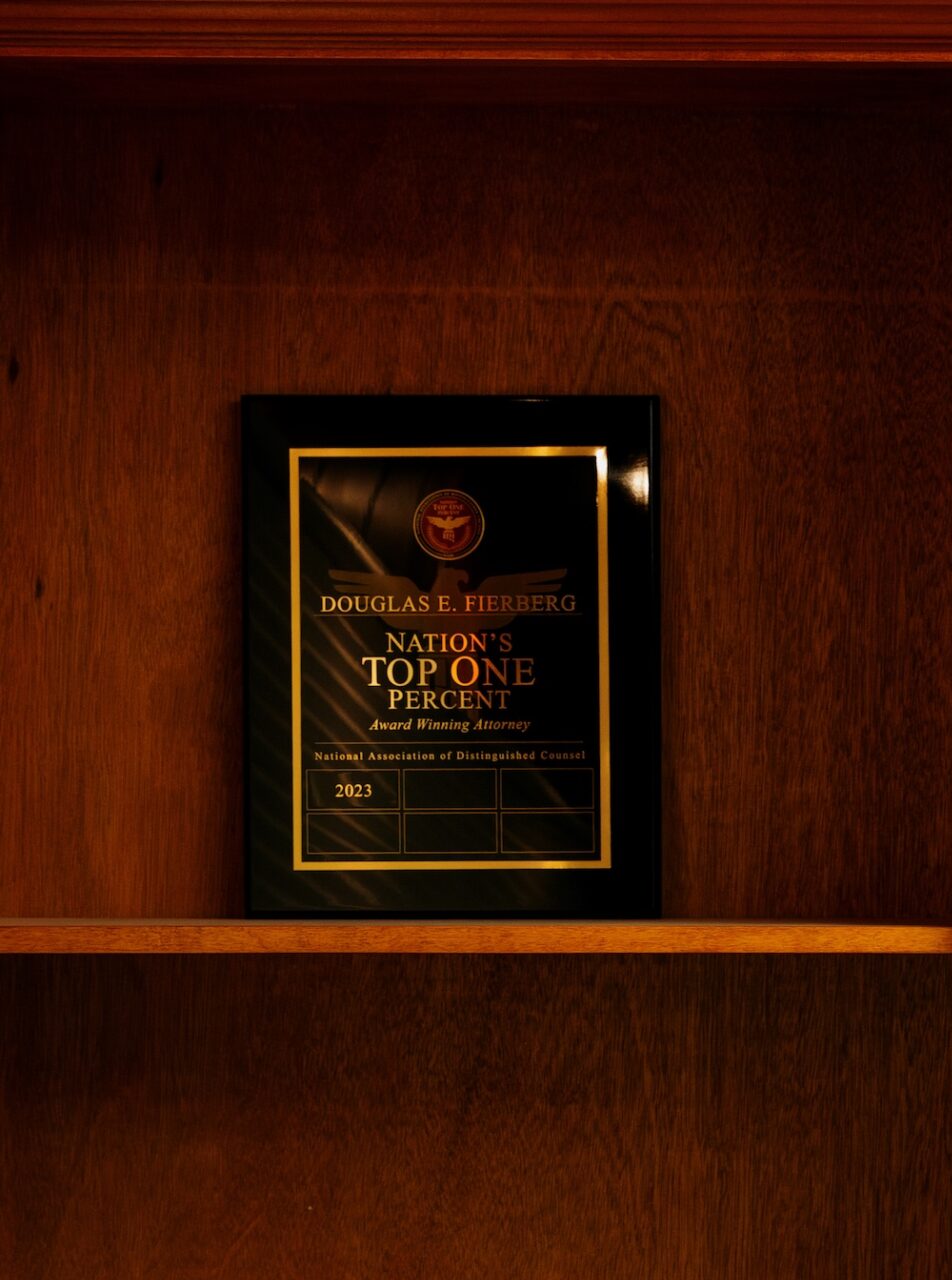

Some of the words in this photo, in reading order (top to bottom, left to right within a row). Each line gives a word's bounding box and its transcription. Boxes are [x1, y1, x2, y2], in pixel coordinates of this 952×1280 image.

[321, 595, 430, 614] DOUGLAS
[437, 595, 457, 613] E.
[464, 594, 575, 613] FIERBERG
[361, 657, 437, 686] TOP
[451, 656, 535, 686] ONE
[388, 691, 510, 710] PERCENT
[369, 718, 412, 731] Award
[417, 718, 469, 732] Winning
[474, 718, 531, 733] Attorney
[315, 751, 363, 761] National
[368, 751, 435, 761] Association
[440, 751, 452, 760] of
[456, 750, 536, 763] Distinguished
[540, 750, 585, 760] Counsel
[335, 783, 373, 799] 2023
